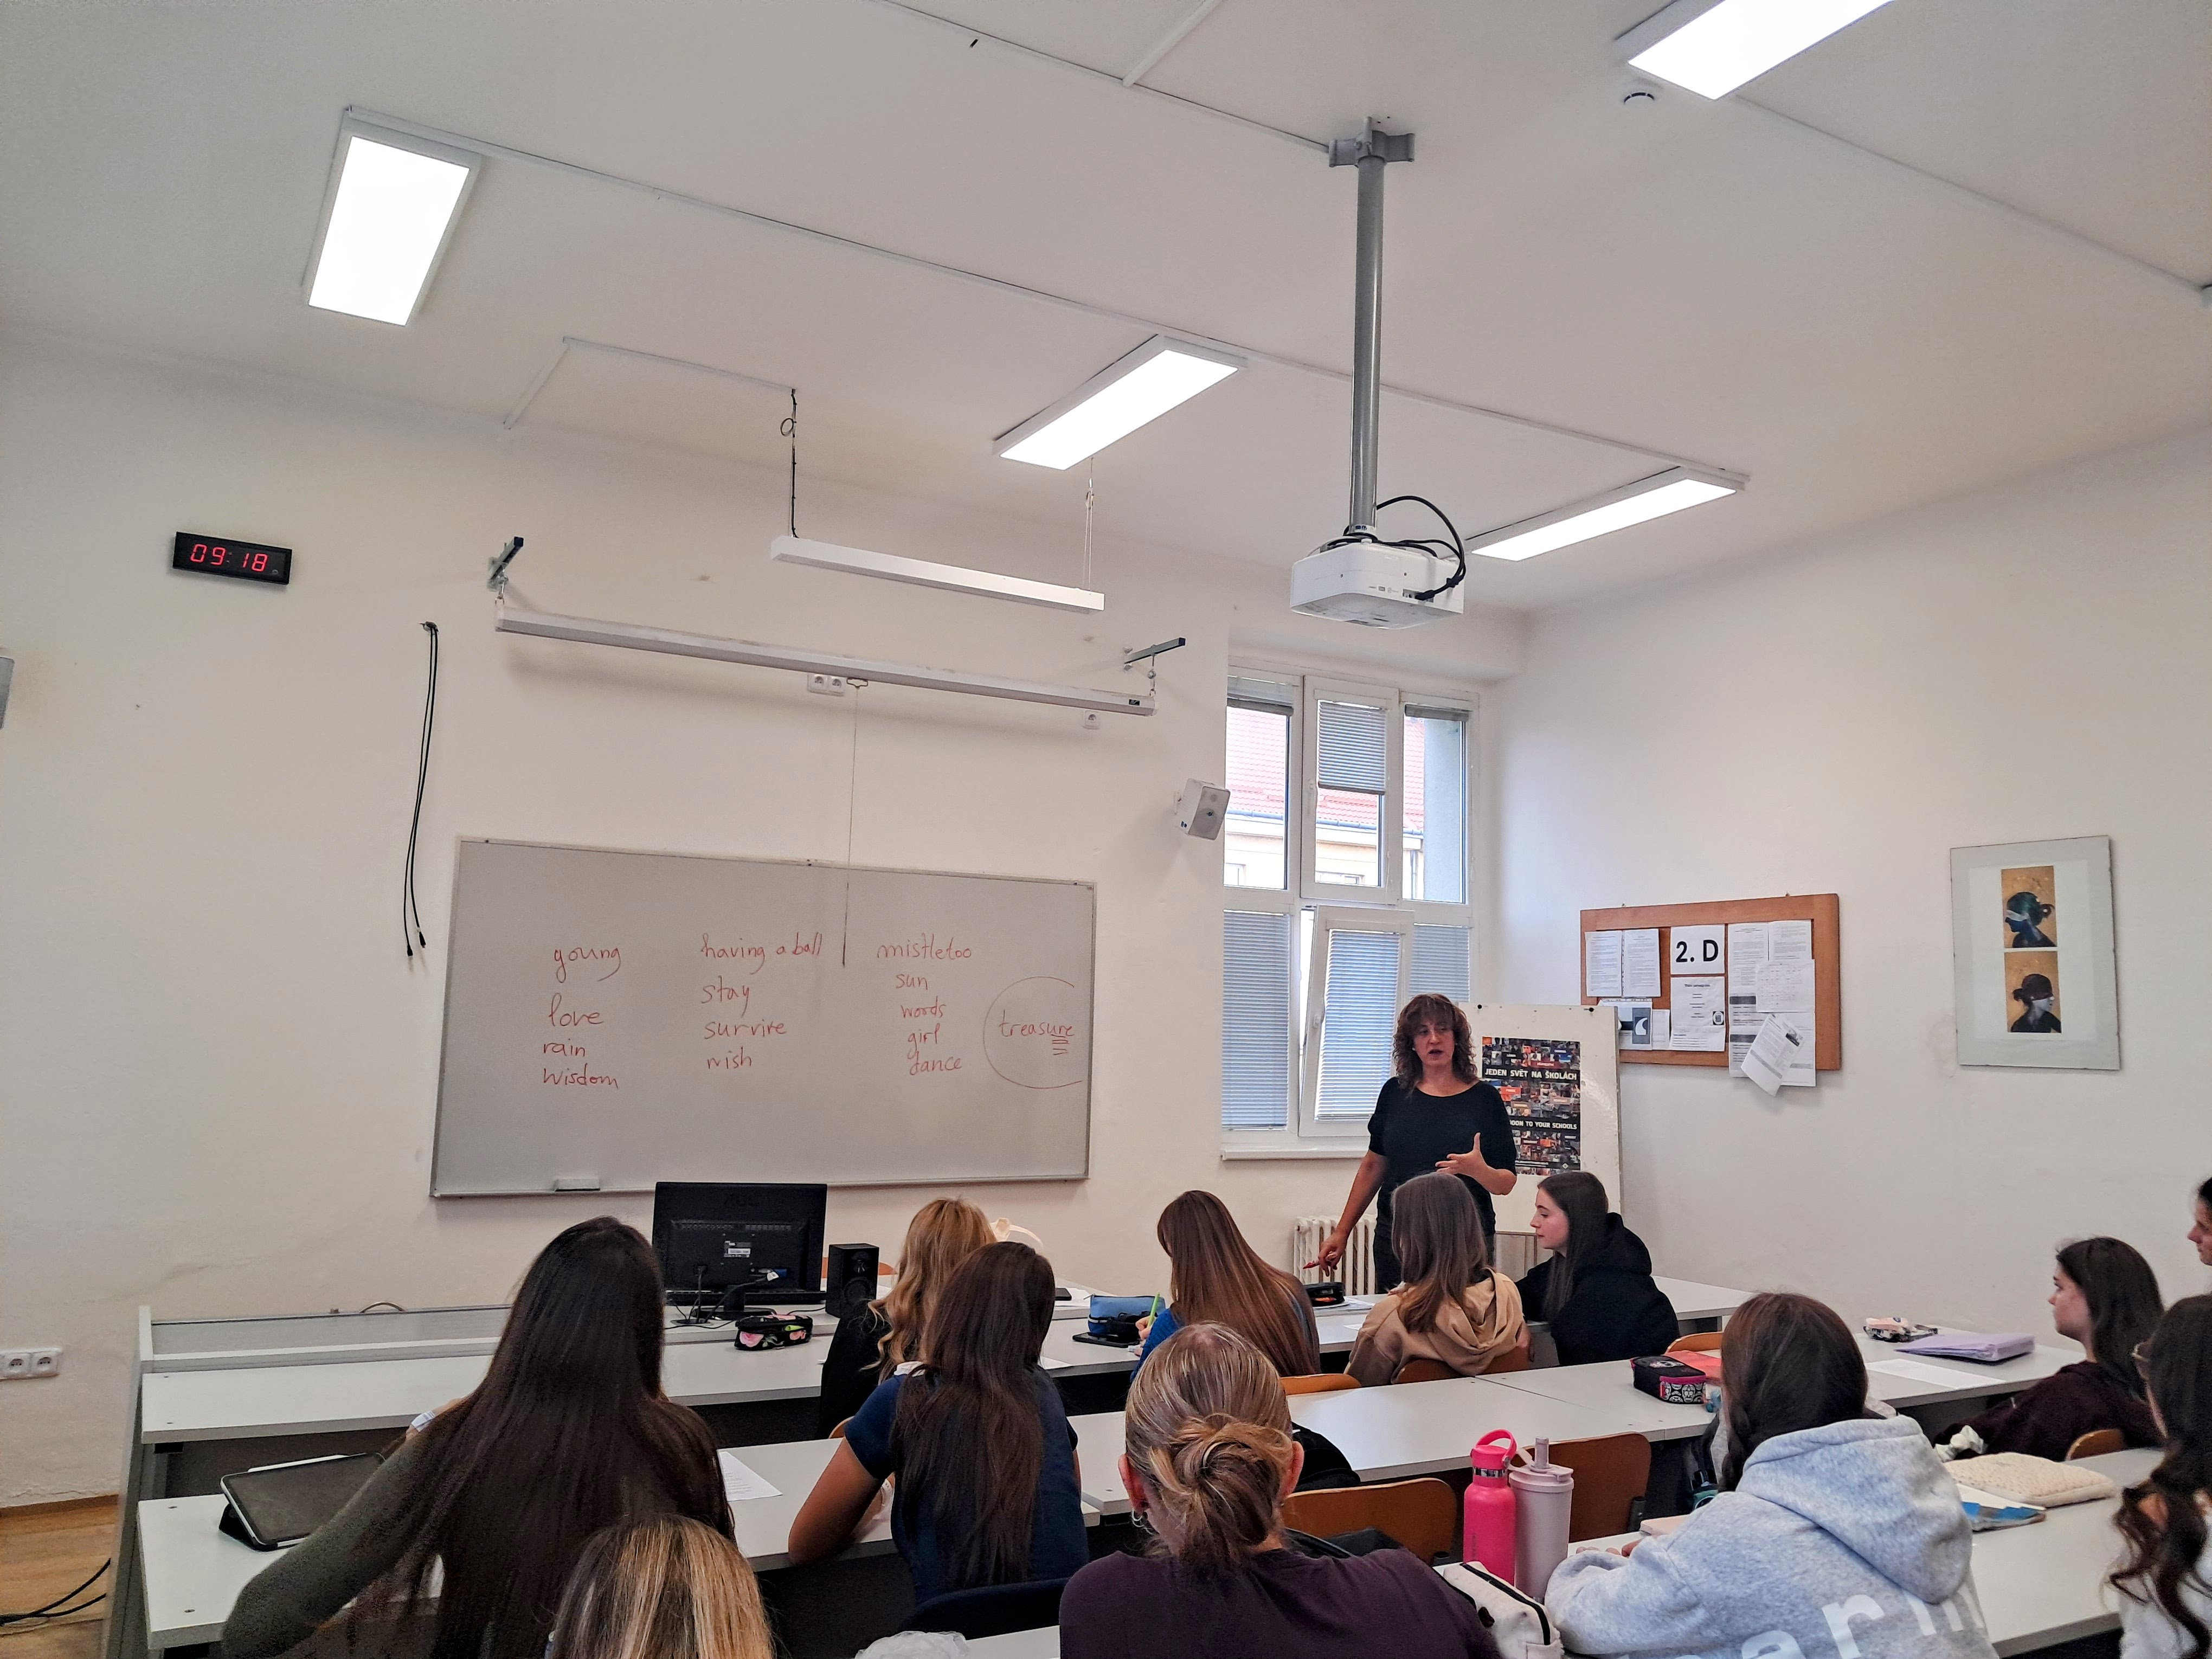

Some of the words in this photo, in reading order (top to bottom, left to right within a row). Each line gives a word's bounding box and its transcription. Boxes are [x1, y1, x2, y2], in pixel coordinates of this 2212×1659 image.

[700, 932, 766, 975] having
[776, 946, 787, 955] a
[792, 931, 822, 956] ball
[1676, 941, 1695, 963] 2.
[1703, 939, 1719, 962] D
[554, 947, 621, 983] young
[896, 974, 928, 991] sun
[549, 992, 605, 1027] love
[701, 975, 749, 1019] stay
[704, 1019, 788, 1040] survive
[999, 1009, 1075, 1037] treasure
[543, 1038, 586, 1057] rain
[907, 1023, 941, 1059] girl
[909, 1051, 963, 1076] dance
[1484, 1068, 1507, 1076] JEDEN
[1510, 1069, 1529, 1078] SVĚT
[1531, 1070, 1542, 1078] NA
[1545, 1070, 1577, 1081] ŠKOLÁCH
